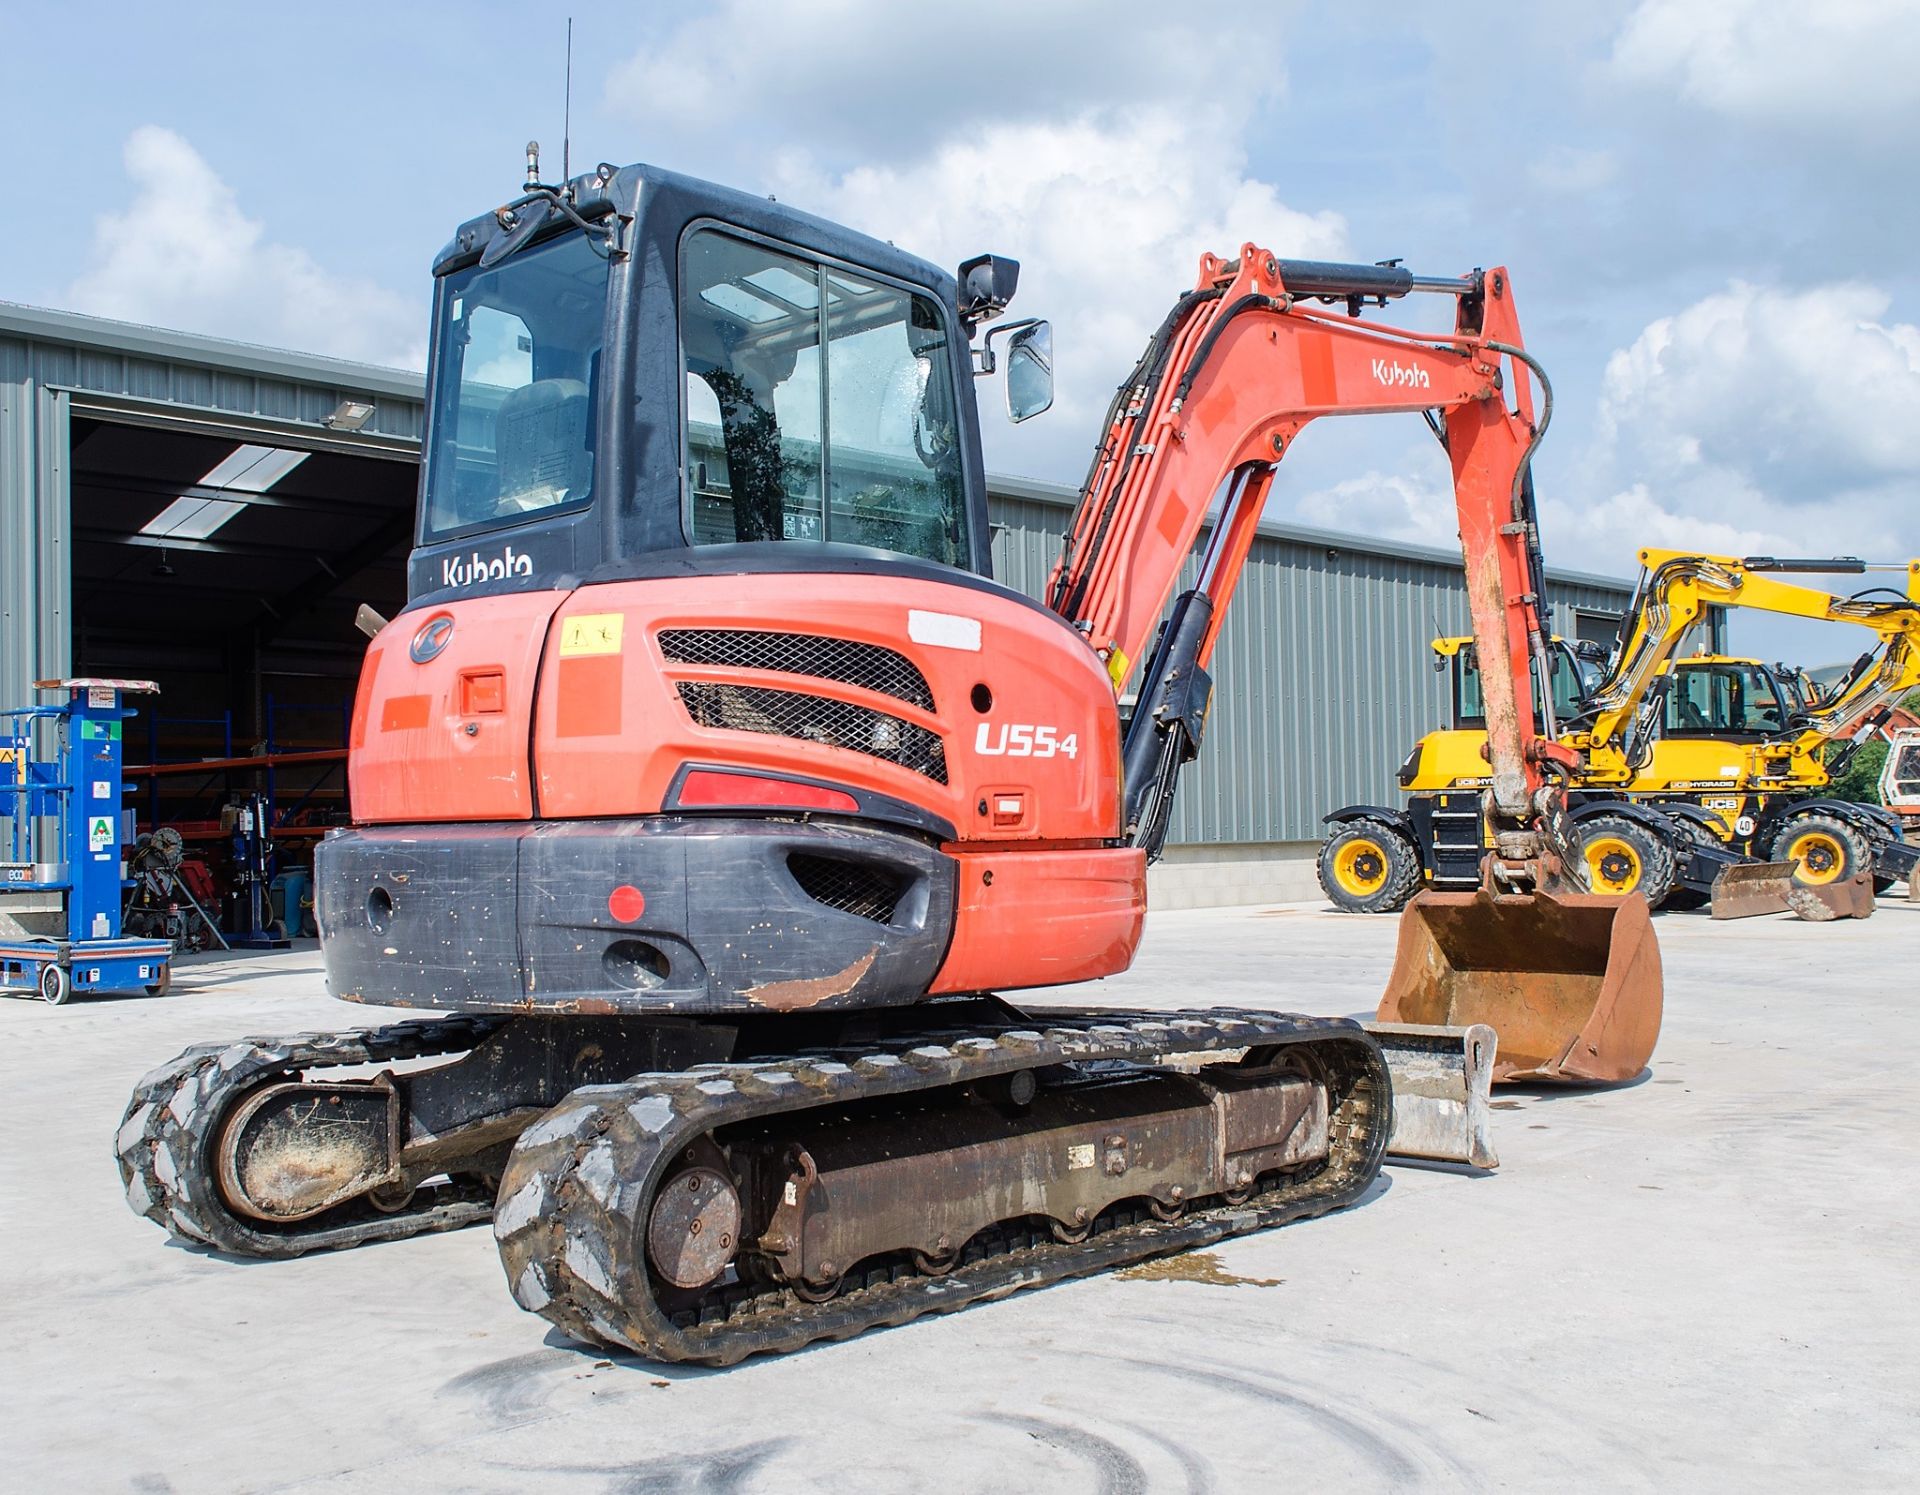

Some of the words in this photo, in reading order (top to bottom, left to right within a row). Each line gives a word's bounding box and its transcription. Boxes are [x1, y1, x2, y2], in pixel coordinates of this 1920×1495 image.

[1372, 359, 1430, 388] Kubota
[443, 546, 533, 588] Kubota
[975, 722, 1078, 760] U55-4
[1704, 799, 1738, 810] JCB
[1739, 821, 1750, 832] 40
